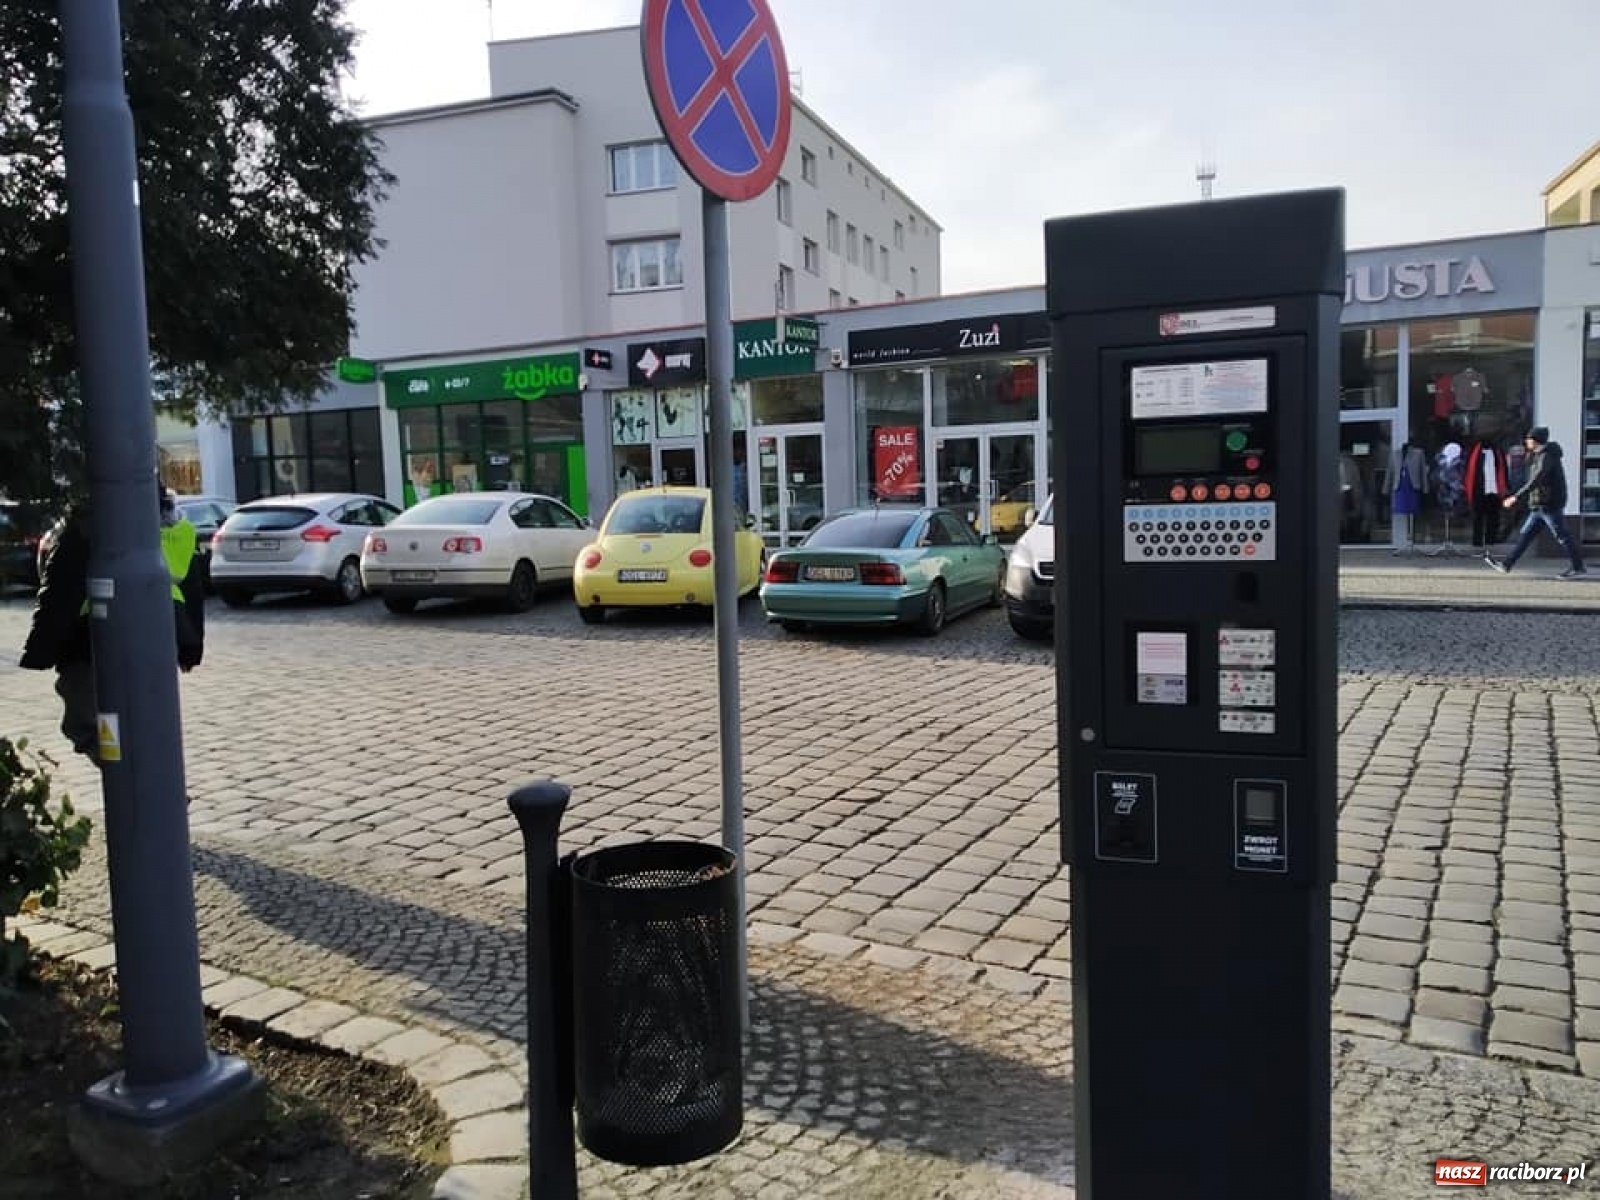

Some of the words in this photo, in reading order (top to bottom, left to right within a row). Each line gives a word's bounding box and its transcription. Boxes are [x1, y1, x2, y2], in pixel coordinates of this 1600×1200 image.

[959, 324, 1000, 348] Zuzi
[503, 362, 574, 390] żabka
[878, 433, 915, 447] SALE
